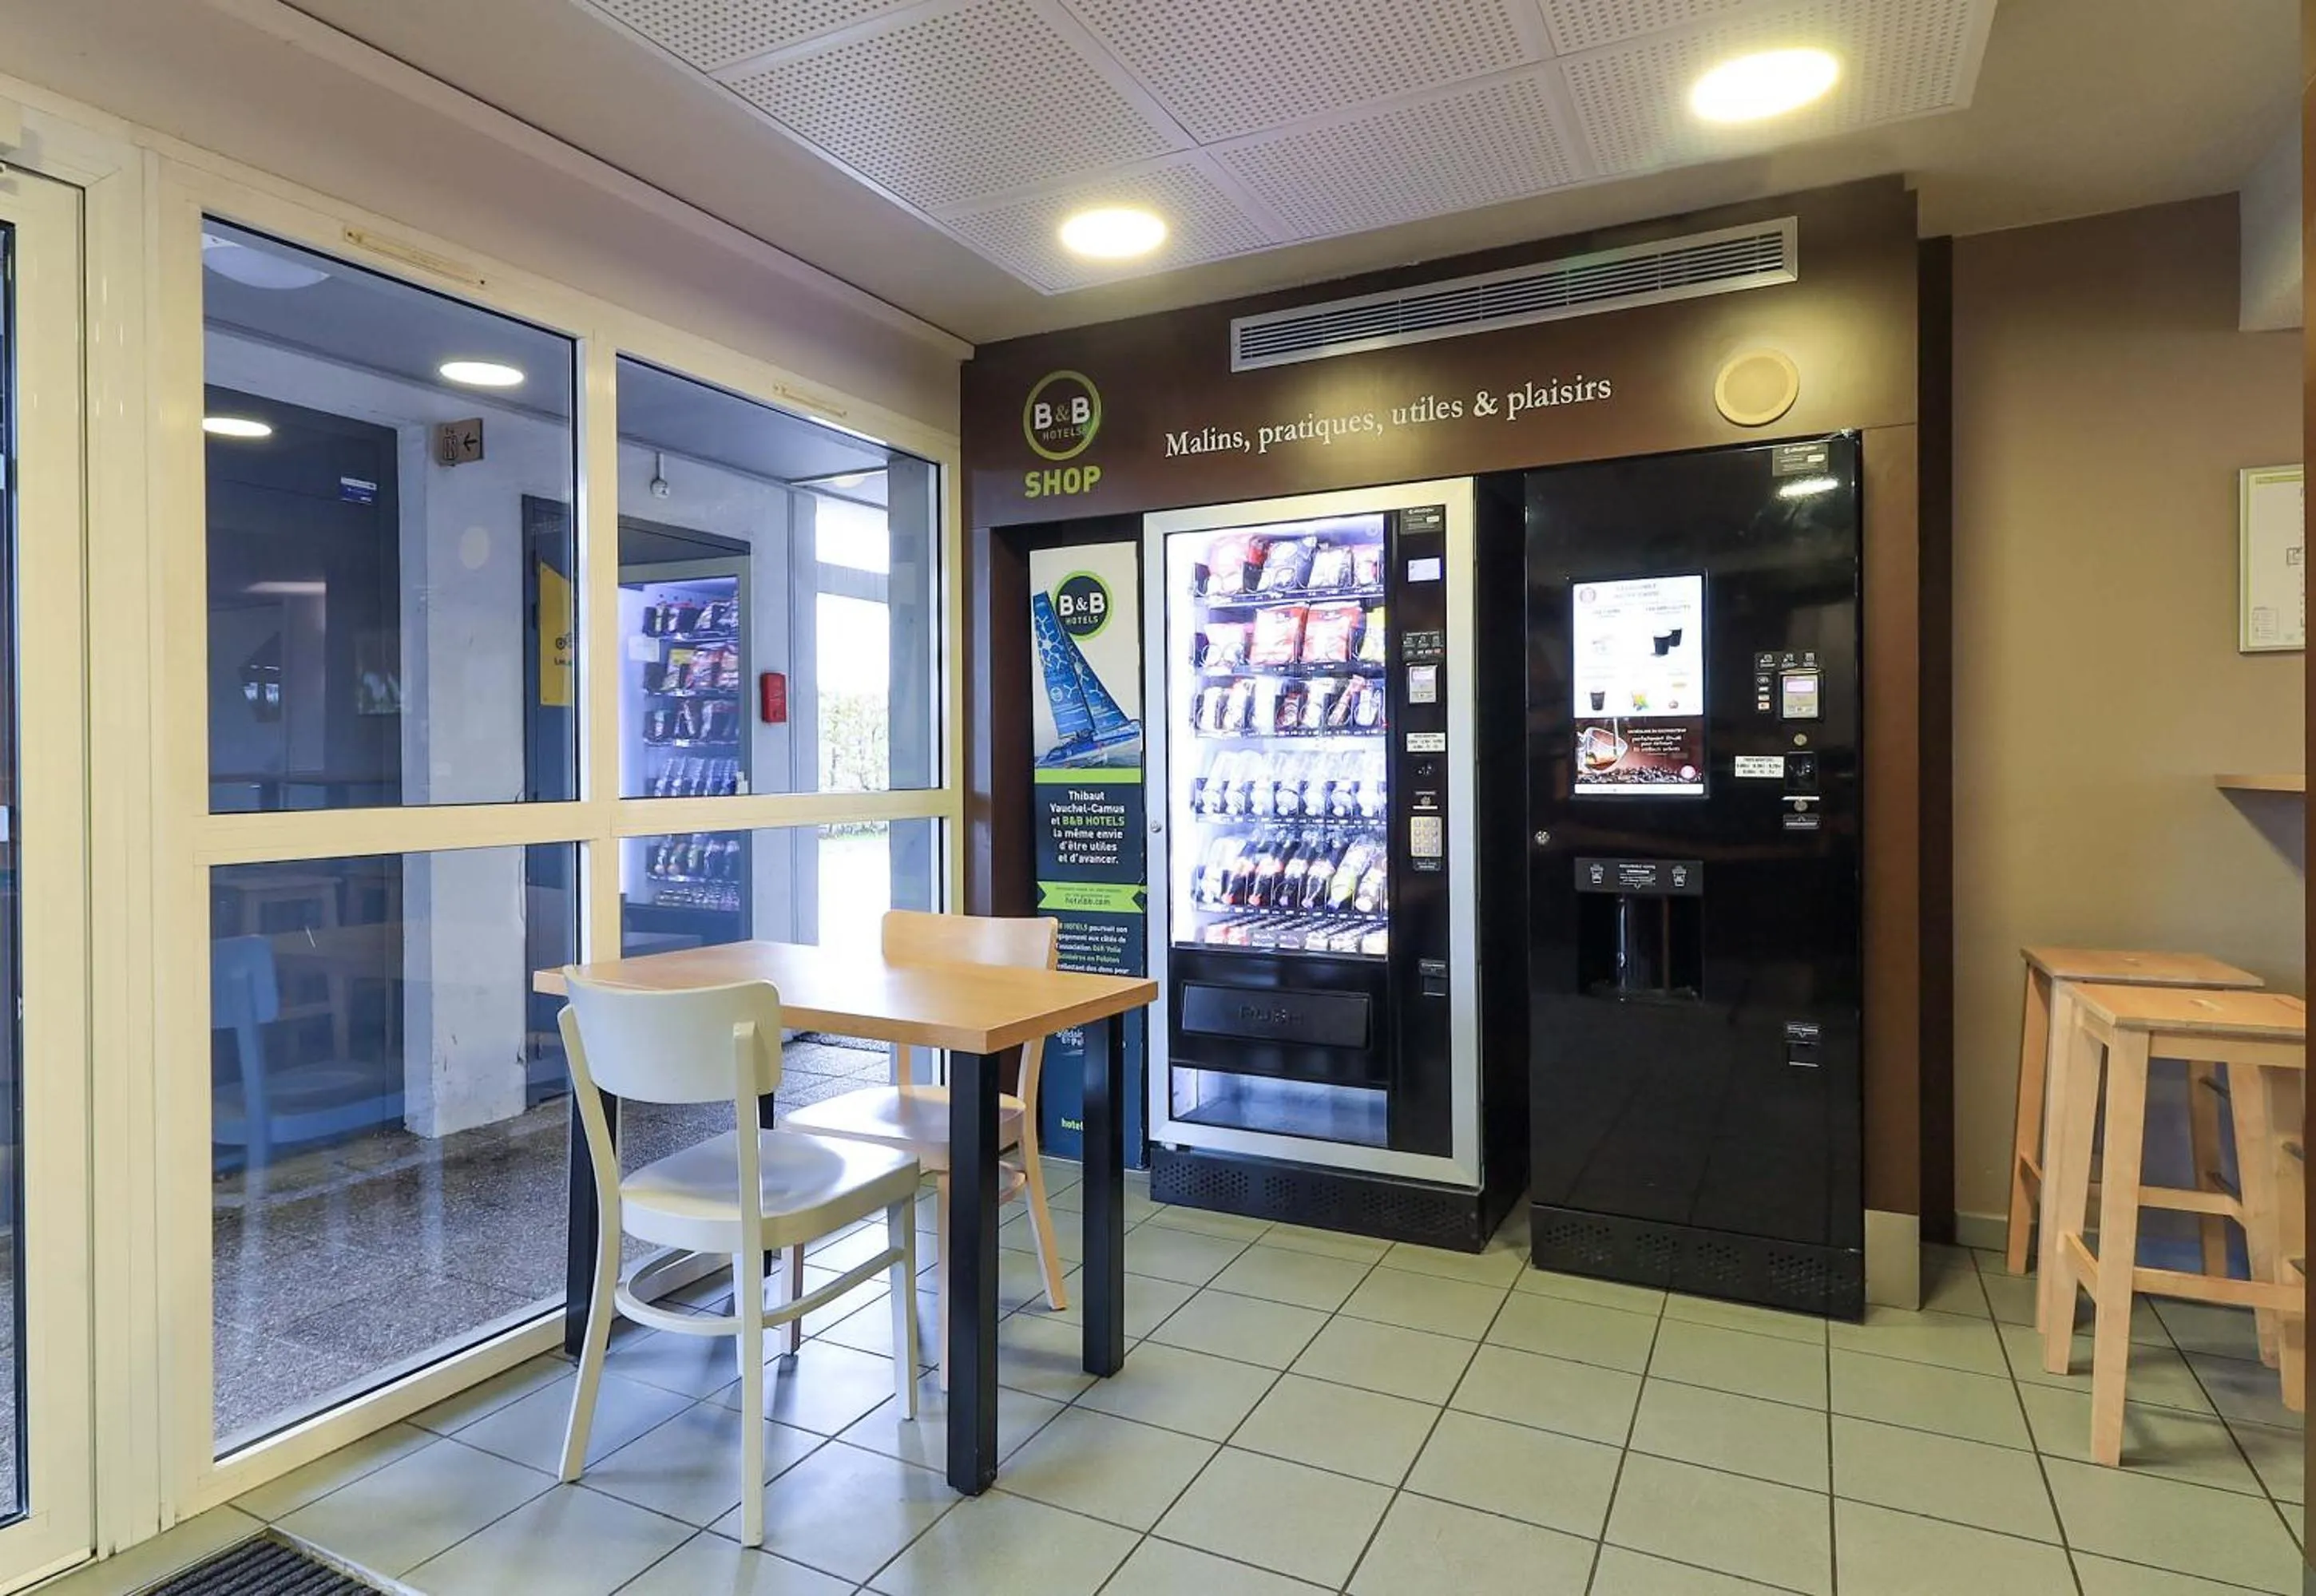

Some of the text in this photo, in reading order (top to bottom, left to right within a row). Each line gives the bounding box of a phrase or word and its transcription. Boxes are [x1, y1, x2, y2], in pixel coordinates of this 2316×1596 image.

[1034, 397, 1091, 430] B&B
[1164, 374, 1612, 457] Malins, pratiques, utiles & plaisirs
[1043, 426, 1081, 441] HOTELS
[1025, 465, 1101, 498] SHOP
[1059, 592, 1105, 616] B&B
[1065, 616, 1099, 625] HOTELS
[1068, 790, 1105, 801] Thibaut
[1049, 802, 1125, 814] Vauchel-Camus
[1051, 815, 1125, 826] et B&B HOTELS
[1053, 828, 1124, 839] la même envie
[1089, 842, 1117, 852] utiles
[1058, 853, 1068, 863] et
[1061, 1117, 1083, 1131] hotel
